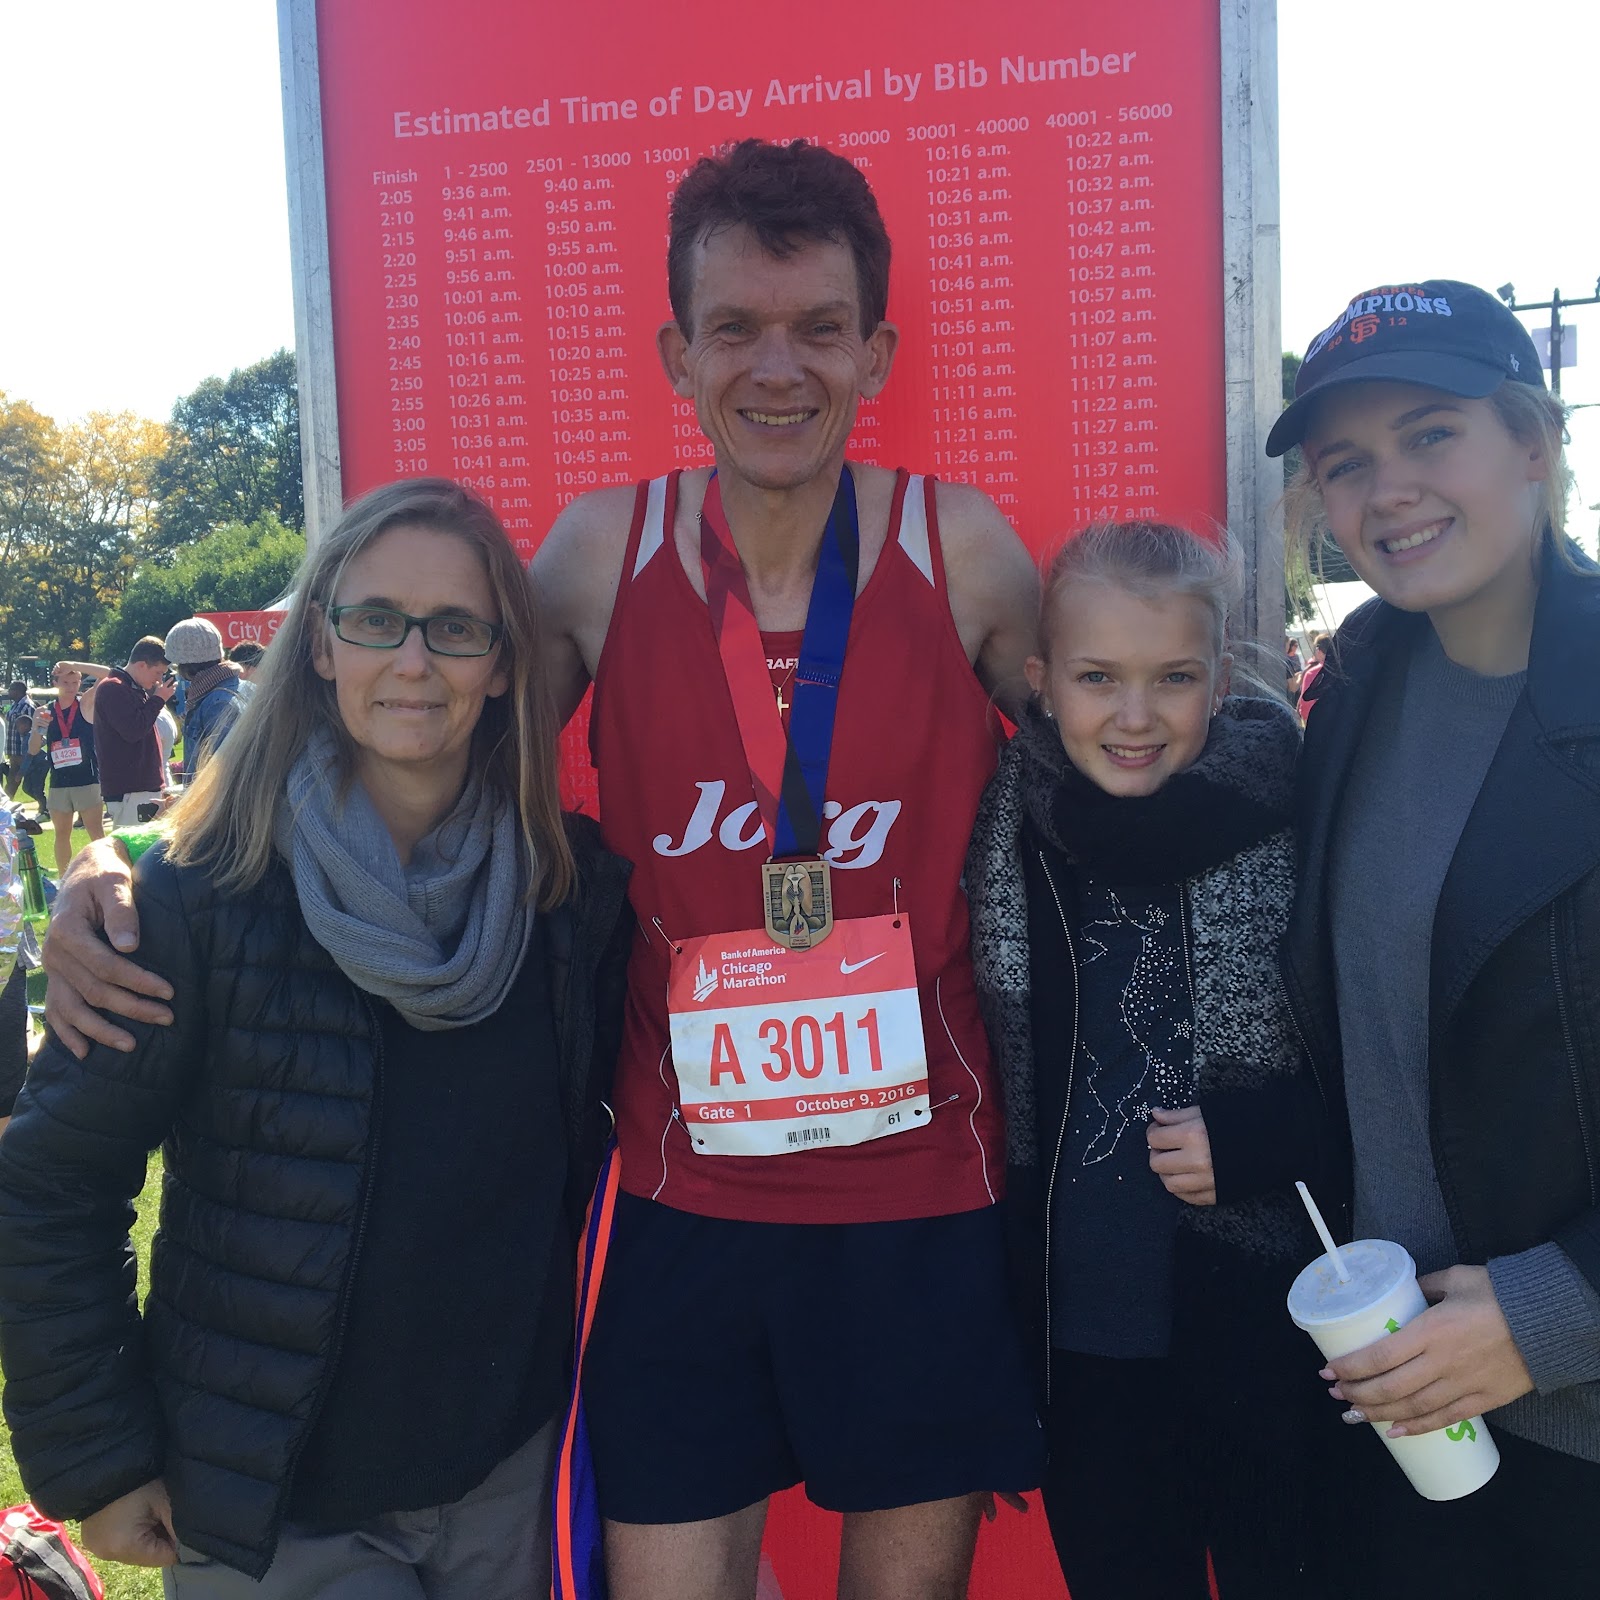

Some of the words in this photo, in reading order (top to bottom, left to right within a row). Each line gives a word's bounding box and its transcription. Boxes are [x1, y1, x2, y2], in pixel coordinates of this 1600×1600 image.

[394, 99, 550, 138] Estimated
[560, 96, 637, 123] Time
[649, 87, 682, 116] of
[694, 86, 752, 117] Day
[764, 69, 871, 107] Arrival
[884, 68, 921, 101] by
[935, 59, 987, 91] Bib
[1001, 48, 1136, 84] Number
[1046, 111, 1096, 128] 40001
[1119, 103, 1172, 121] 56000
[907, 124, 955, 141] 30001
[976, 117, 1029, 134] 40000
[838, 130, 890, 147] 30000
[1066, 132, 1112, 148] 10:22
[1119, 132, 1153, 144] a.m.
[644, 147, 689, 163] 13001
[926, 144, 971, 161] 10:16
[977, 145, 1010, 157] a.m.
[527, 158, 562, 173] 2501
[583, 152, 631, 168] 13000
[1067, 154, 1112, 171] 10:27
[1119, 154, 1153, 166] a.m.
[374, 169, 417, 185] Finish
[444, 166, 450, 180] 1
[469, 162, 507, 177] 2500
[927, 166, 969, 183] 10:21
[978, 167, 1011, 179] a.m.
[544, 178, 577, 192] 9:40
[583, 178, 614, 190] a.m.
[1067, 176, 1113, 193] 10:32
[1120, 177, 1154, 189] a.m.
[380, 190, 412, 205] 2:05
[442, 186, 475, 200] 9:36
[480, 186, 511, 197] a.m.
[928, 188, 972, 205] 10:26
[978, 189, 1011, 201] a.m.
[443, 207, 473, 221] 9:41
[481, 208, 512, 218] a.m.
[545, 199, 578, 214] 9:45
[584, 200, 615, 211] a.m.
[381, 211, 413, 226] 2:10
[444, 228, 477, 242] 9:46
[483, 229, 513, 239] a.m.
[547, 220, 579, 235] 9:50
[585, 221, 616, 232] a.m.
[1068, 221, 1113, 237] 10:42
[1121, 221, 1154, 233] a.m.
[383, 232, 414, 246] 2:15
[929, 233, 973, 249] 10:36
[980, 233, 1012, 245] a.m.
[1069, 243, 1113, 259] 10:47
[1121, 244, 1155, 255] a.m.
[384, 253, 416, 267] 2:20
[929, 254, 971, 270] 10:41
[980, 255, 1013, 267] a.m.
[447, 269, 479, 284] 9:56
[485, 271, 515, 281] a.m.
[545, 262, 586, 277] 10:00
[592, 263, 623, 274] a.m.
[1069, 265, 1114, 282] 10:52
[1121, 266, 1155, 278] a.m.
[385, 274, 416, 288] 2:25
[930, 276, 974, 292] 10:46
[981, 277, 1013, 289] a.m.
[444, 290, 482, 304] 10:01
[491, 291, 521, 302] a.m.
[546, 283, 587, 298] 10:05
[593, 284, 624, 295] a.m.
[386, 294, 418, 308] 2:30
[445, 311, 486, 325] 10:06
[492, 312, 522, 323] a.m.
[547, 304, 588, 319] 10:10
[594, 305, 625, 316] a.m.
[1070, 309, 1115, 325] 11:02
[1122, 310, 1156, 322] a.m.
[387, 315, 419, 329] 2:35
[931, 320, 975, 336] 10:56
[982, 321, 1014, 332] a.m.
[1306, 292, 1452, 363] CHAMPIONS
[1389, 317, 1407, 327] 12
[388, 336, 420, 350] 2:40
[1070, 331, 1115, 347] 11:07
[1123, 332, 1156, 344] a.m.
[549, 346, 590, 361] 10:20
[596, 347, 627, 358] a.m.
[932, 342, 973, 357] 11:01
[982, 343, 1015, 354] a.m.
[389, 356, 421, 370] 2:45
[447, 352, 488, 367] 10:16
[494, 354, 524, 364] a.m.
[1071, 353, 1116, 369] 11:12
[1123, 354, 1156, 366] a.m.
[550, 367, 591, 381] 10:25
[597, 368, 627, 379] a.m.
[932, 363, 976, 379] 11:06
[983, 364, 1015, 376] a.m.
[391, 377, 423, 391] 2:50
[448, 373, 486, 387] 10:21
[495, 374, 525, 385] a.m.
[450, 394, 490, 408] 10:26
[496, 395, 526, 405] a.m.
[551, 388, 592, 402] 10:30
[598, 389, 628, 400] a.m.
[392, 397, 423, 411] 2:55
[1072, 397, 1117, 413] 11:22
[1124, 398, 1157, 409] a.m.
[933, 406, 977, 422] 11:16
[984, 408, 1016, 419] a.m.
[393, 418, 425, 431] 3:00
[1072, 419, 1116, 434] 11:27
[1124, 420, 1158, 431] a.m.
[452, 435, 493, 449] 10:36
[498, 436, 528, 447] a.m.
[553, 429, 594, 444] 10:40
[600, 431, 630, 441] a.m.
[934, 428, 975, 443] 11:21
[984, 429, 1017, 440] a.m.
[394, 438, 426, 452] 3:05
[1072, 441, 1117, 456] 11:32
[1124, 442, 1158, 453] a.m.
[453, 455, 491, 469] 10:41
[499, 457, 529, 467] a.m.
[554, 450, 595, 464] 10:45
[601, 452, 631, 462] a.m.
[395, 459, 427, 472] 3:10
[555, 471, 596, 485] 10:50
[602, 472, 632, 482] a.m.
[1073, 484, 1118, 499] 11:42
[1125, 485, 1158, 496] a.m.
[228, 620, 262, 643] City
[766, 658, 799, 670] RAFT
[721, 951, 742, 961] Bank
[742, 949, 751, 958] of
[752, 947, 786, 958] America
[722, 961, 772, 976] Chicago
[723, 975, 786, 989] Marathon
[710, 1023, 746, 1087] A
[758, 1008, 883, 1082] 3011
[795, 1096, 857, 1113] October
[859, 1093, 874, 1107] 9,
[878, 1085, 916, 1103] 2016
[699, 1106, 735, 1120] Gate
[744, 1104, 752, 1118] 1
[888, 1112, 901, 1125] 61
